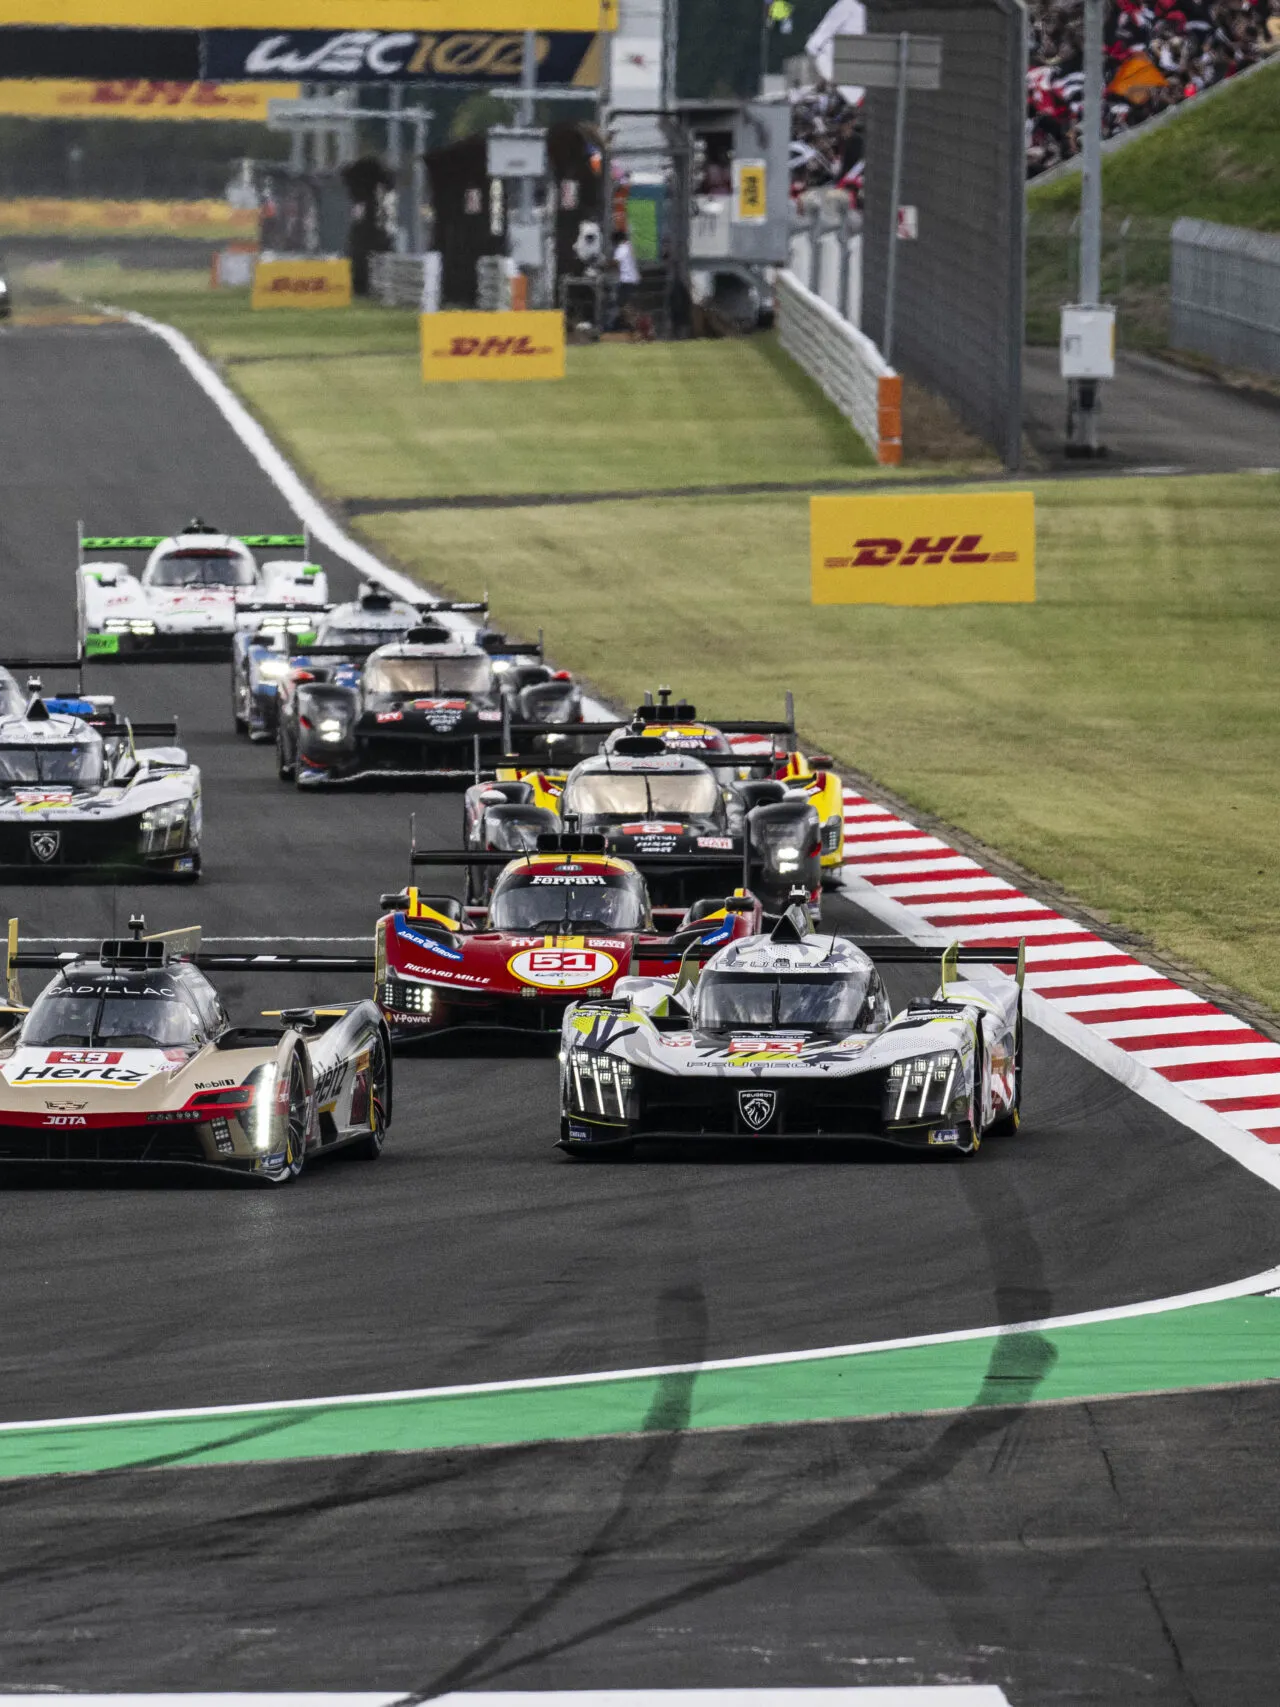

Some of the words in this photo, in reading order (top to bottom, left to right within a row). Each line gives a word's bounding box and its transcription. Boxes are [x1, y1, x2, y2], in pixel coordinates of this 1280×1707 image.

[449, 335, 536, 357] DHL
[851, 535, 991, 567] DHL
[529, 876, 607, 885] Ferrari
[398, 931, 424, 945] ADLER
[533, 954, 593, 970] 51
[404, 962, 453, 978] RICHARD
[455, 973, 491, 984] MILLE
[48, 986, 175, 997] CADILLAC
[393, 1014, 431, 1023] V-Power
[733, 1042, 801, 1051] 93
[15, 1066, 148, 1082] Hertz
[42, 1116, 87, 1125] JOTA
